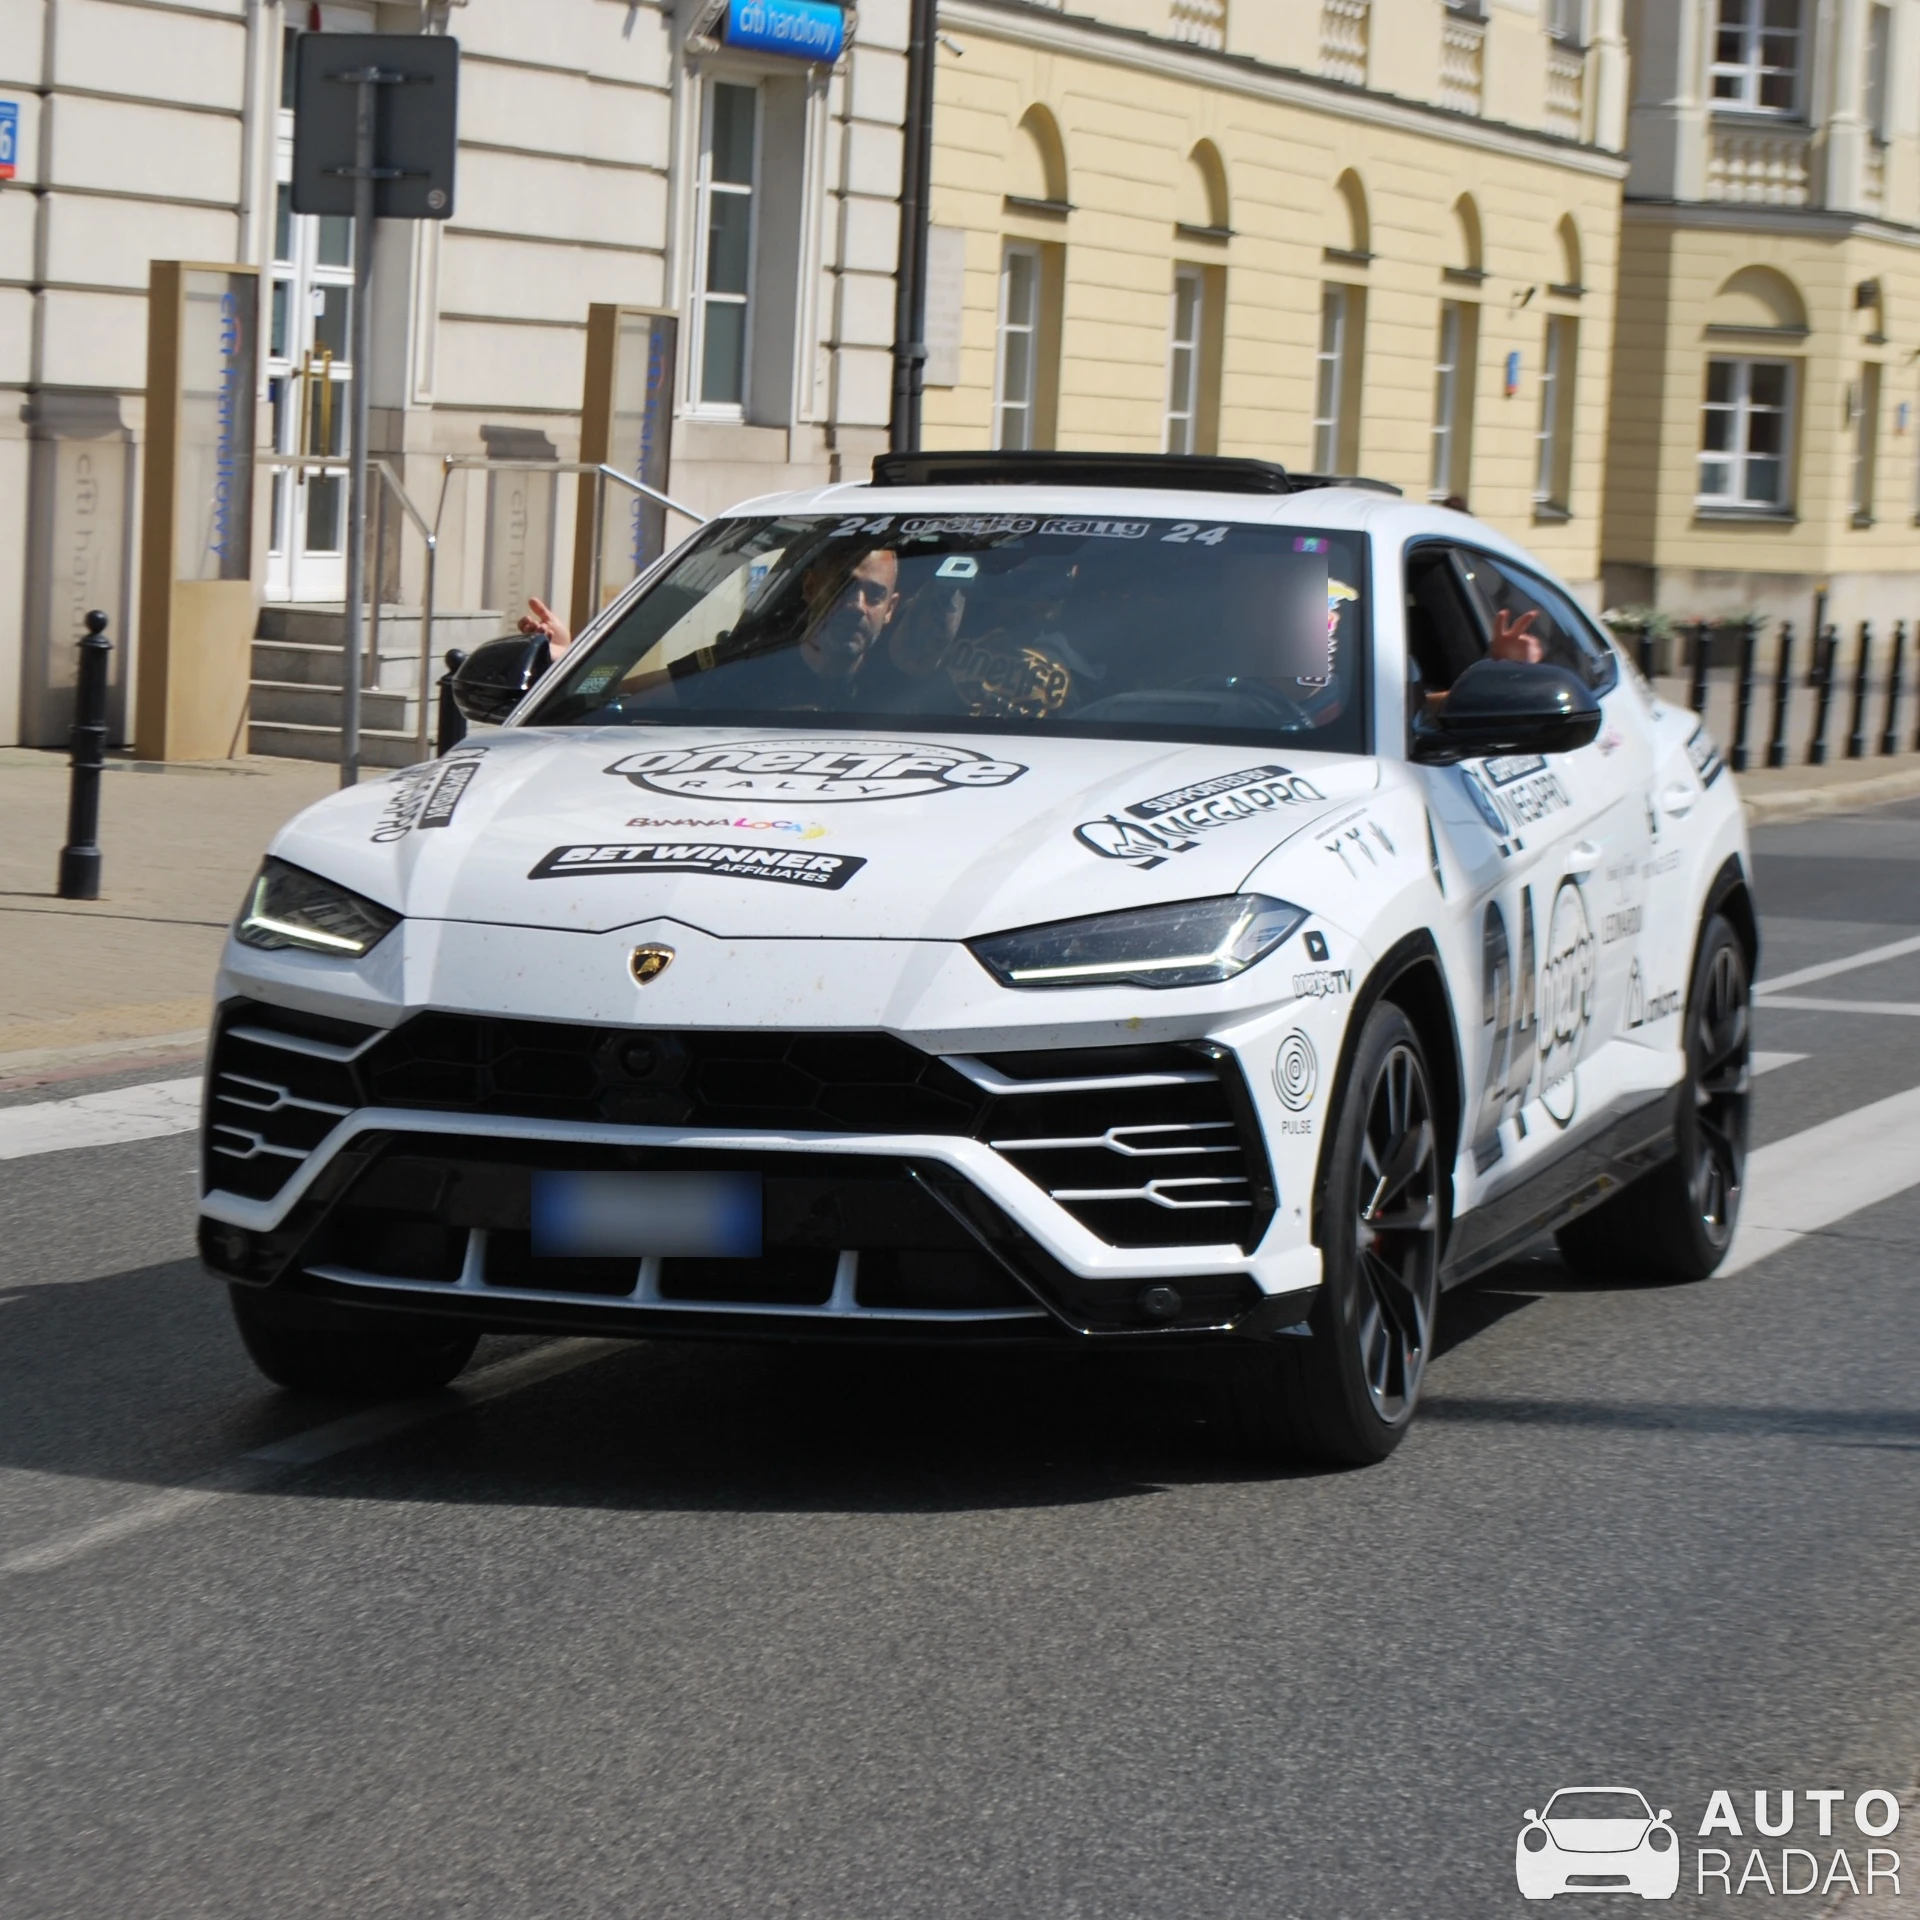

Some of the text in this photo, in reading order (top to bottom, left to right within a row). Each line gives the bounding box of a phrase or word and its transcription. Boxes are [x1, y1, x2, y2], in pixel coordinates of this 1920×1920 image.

[740, 4, 837, 54] citi handlowy
[219, 293, 238, 355] citi
[828, 515, 896, 538] 24
[1160, 522, 1231, 546] 24
[678, 779, 889, 796] RALLY
[1142, 768, 1275, 812] SUPPORTED BY
[557, 844, 843, 873] BETWINNER
[713, 861, 831, 884] AFFILIATES
[1281, 1120, 1313, 1135] PULSE
